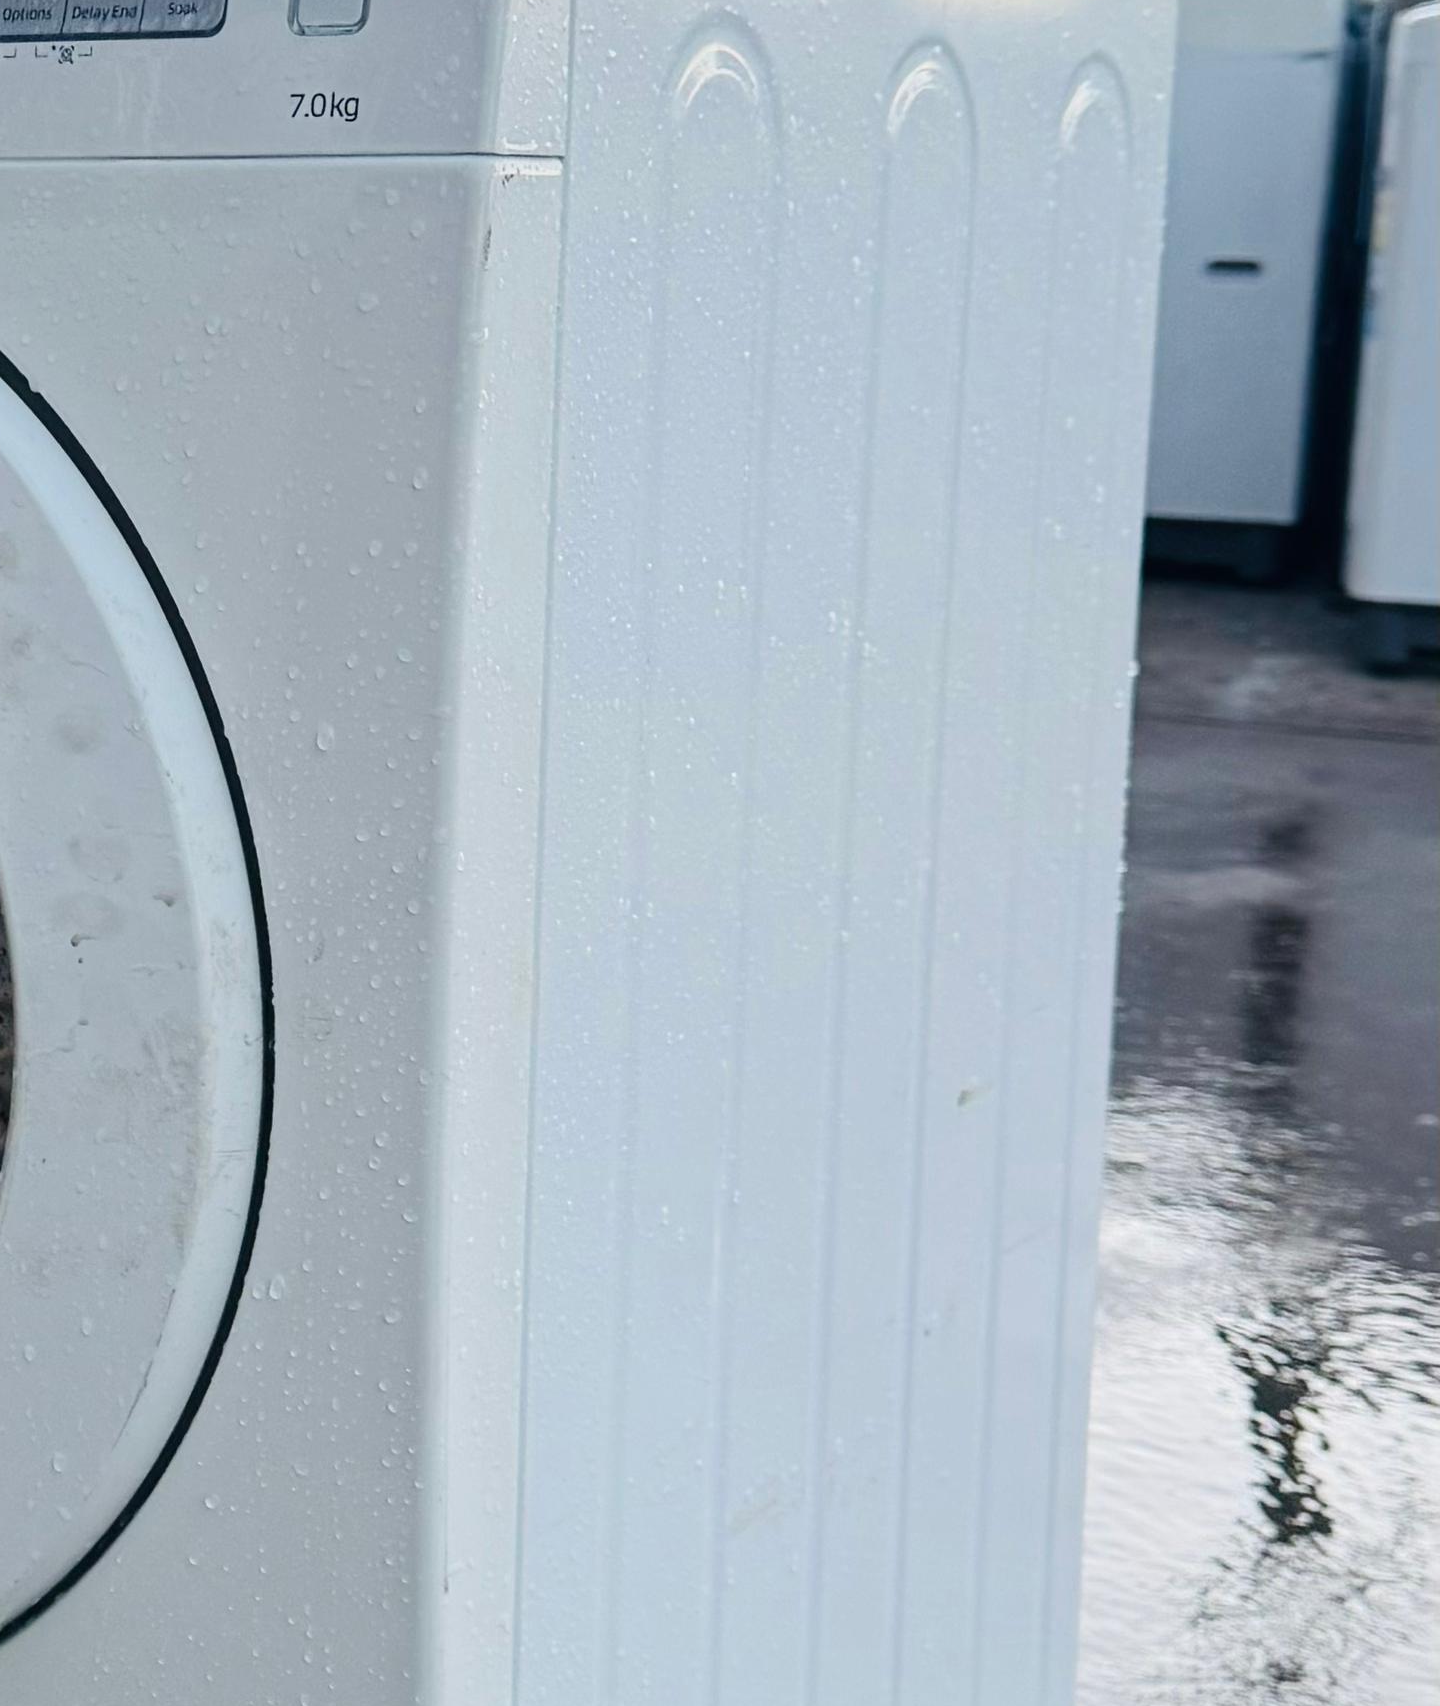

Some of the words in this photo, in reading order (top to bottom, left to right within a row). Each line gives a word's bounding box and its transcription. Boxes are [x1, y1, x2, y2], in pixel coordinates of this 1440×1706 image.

[2, 6, 52, 23] Options
[71, 5, 110, 22] Delay
[111, 4, 138, 19] End
[167, 1, 198, 16] Soak
